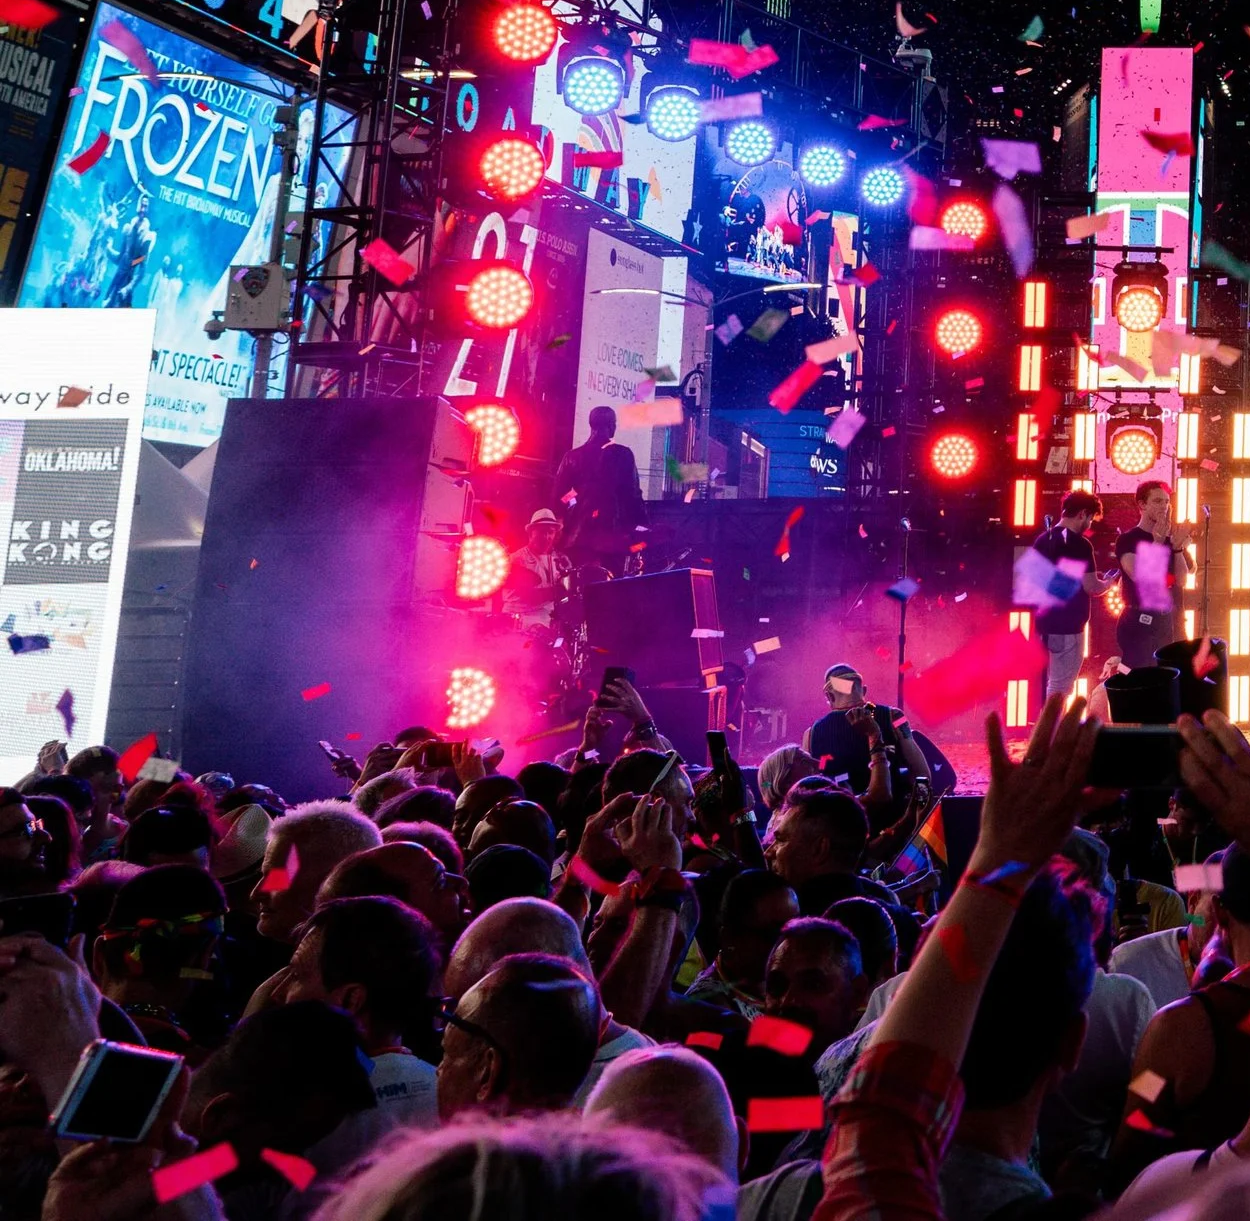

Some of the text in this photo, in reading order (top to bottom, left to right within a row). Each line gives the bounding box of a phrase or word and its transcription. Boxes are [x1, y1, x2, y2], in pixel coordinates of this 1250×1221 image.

[71, 39, 276, 209] FROZEN
[158, 184, 251, 228] THE HIT BROADWAY MUSICAL
[597, 341, 618, 365] LOVE
[57, 383, 130, 407] Pide
[597, 372, 621, 398] EVERY
[152, 395, 190, 413] AVAILABLE
[24, 446, 120, 472] OKLAHOMA!
[11, 520, 113, 541] KING
